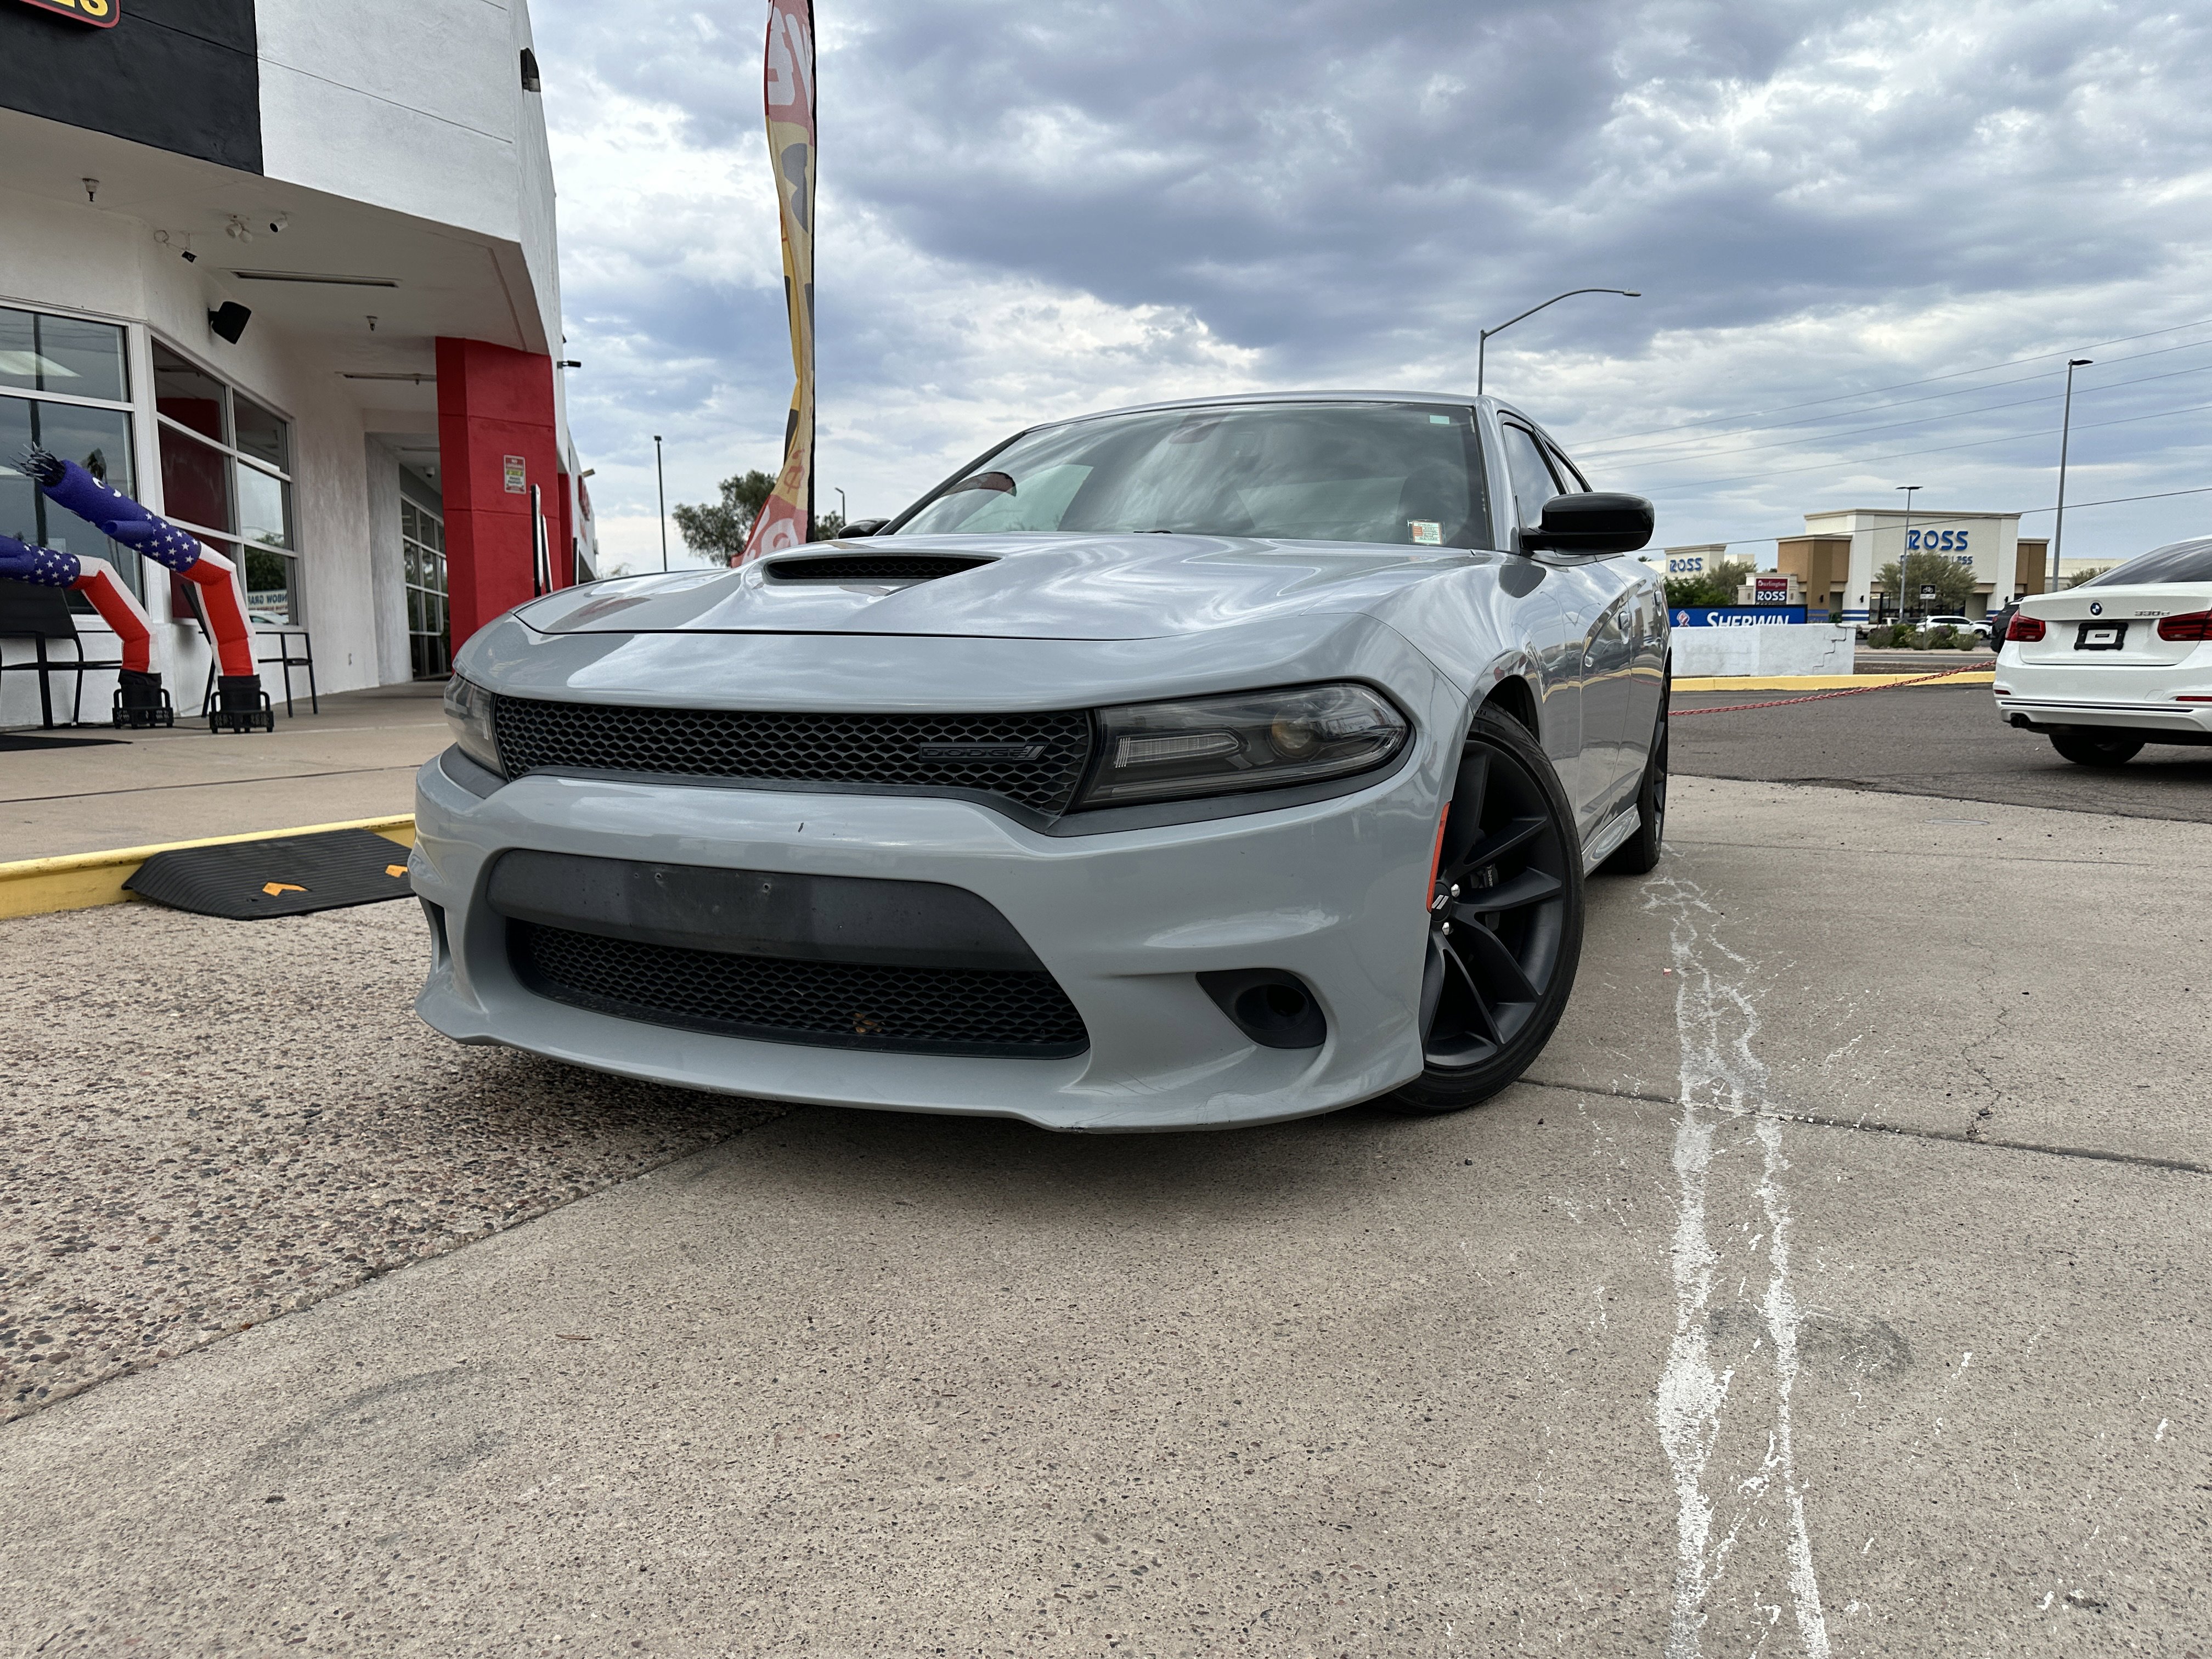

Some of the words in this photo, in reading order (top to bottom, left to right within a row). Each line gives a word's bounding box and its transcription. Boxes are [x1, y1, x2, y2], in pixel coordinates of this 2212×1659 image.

[1907, 530, 1968, 551] ROSS
[1669, 557, 1703, 573] ROSS
[1758, 580, 1786, 588] Burlington
[1757, 591, 1786, 601] ROSS
[923, 748, 1027, 757] DODGE
